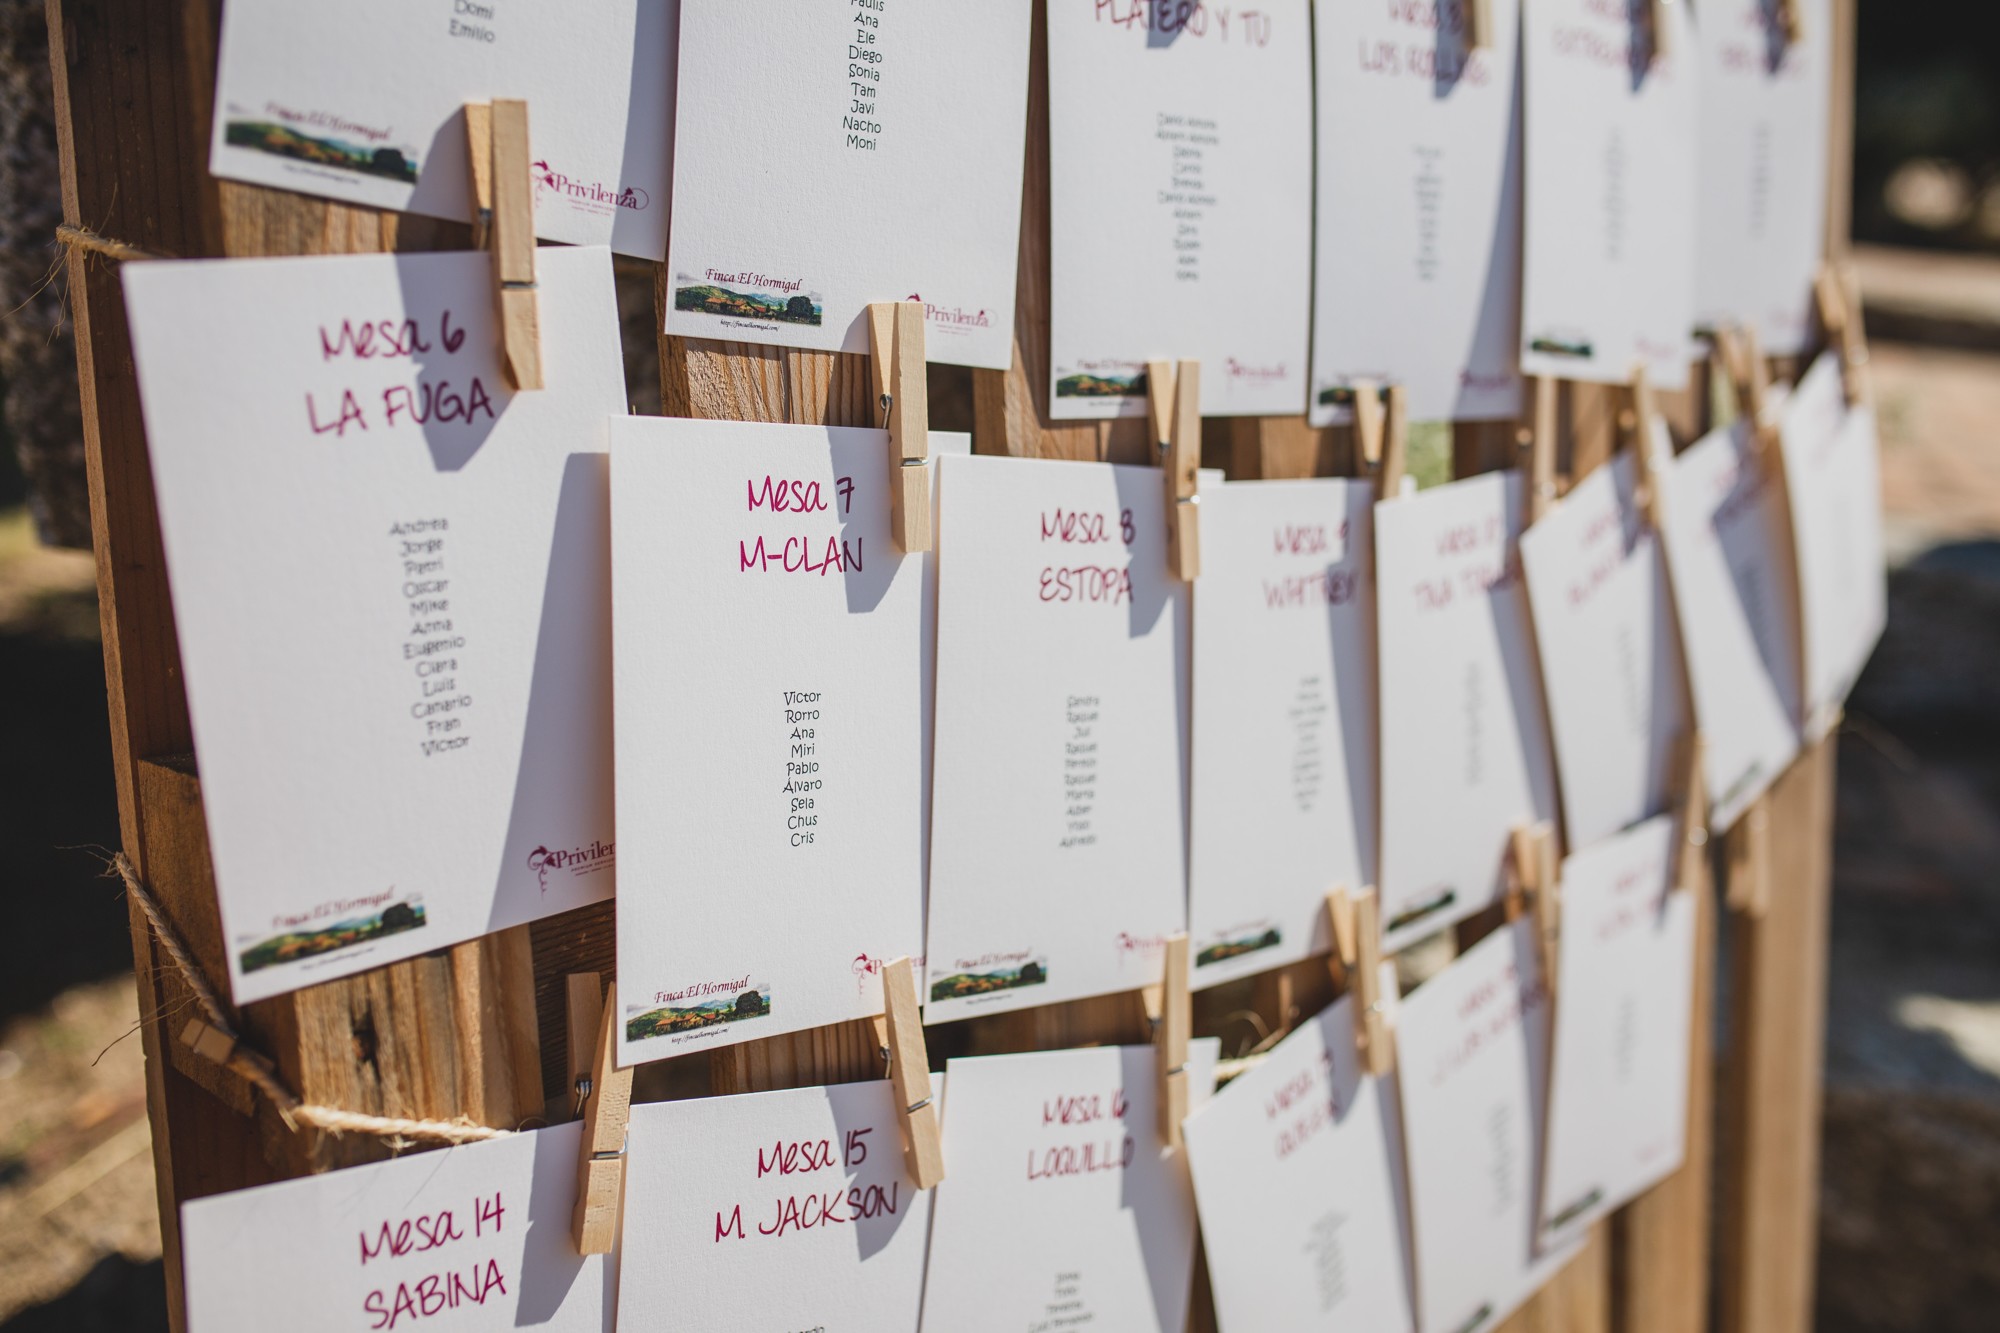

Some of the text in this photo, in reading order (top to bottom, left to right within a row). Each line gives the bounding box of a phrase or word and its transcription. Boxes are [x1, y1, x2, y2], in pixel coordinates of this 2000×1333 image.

[853, 11, 879, 28] Ana
[1214, 7, 1231, 42] Y
[449, 19, 496, 43] Emilio
[856, 29, 876, 44] Ele
[848, 45, 883, 63] Diego
[849, 63, 880, 81] Sonia
[851, 82, 876, 98] Tam
[851, 99, 875, 115] Javi
[842, 115, 882, 133] Nacho
[846, 134, 877, 150] Moni
[555, 174, 638, 210] Privilenza
[705, 268, 803, 294] Finca El Hormigal
[320, 310, 466, 361] Mesa 6
[306, 376, 494, 436] LA FUGA
[748, 475, 855, 514] Mesa 7
[1042, 507, 1136, 546] Mesa 8
[740, 535, 862, 576] M-CLAN
[1040, 565, 1134, 605] ESTOPA
[403, 635, 466, 660] Eugenio
[783, 691, 822, 706] Victor
[784, 709, 820, 724] Rorro
[789, 726, 815, 740] Ana
[791, 743, 815, 758] Miri
[786, 762, 819, 776] Pablo
[782, 777, 822, 794] Álvaro
[790, 797, 815, 813] Sela
[787, 815, 818, 830] Chus
[790, 831, 815, 847] Cris
[654, 974, 750, 1003] Finca El Hormigal
[1043, 1095, 1103, 1128] Mesa
[758, 1127, 873, 1179] Mesa 15
[715, 1181, 898, 1243] M. JACKSON
[360, 1191, 505, 1265] Mesa 14
[363, 1258, 507, 1330] SABINA
